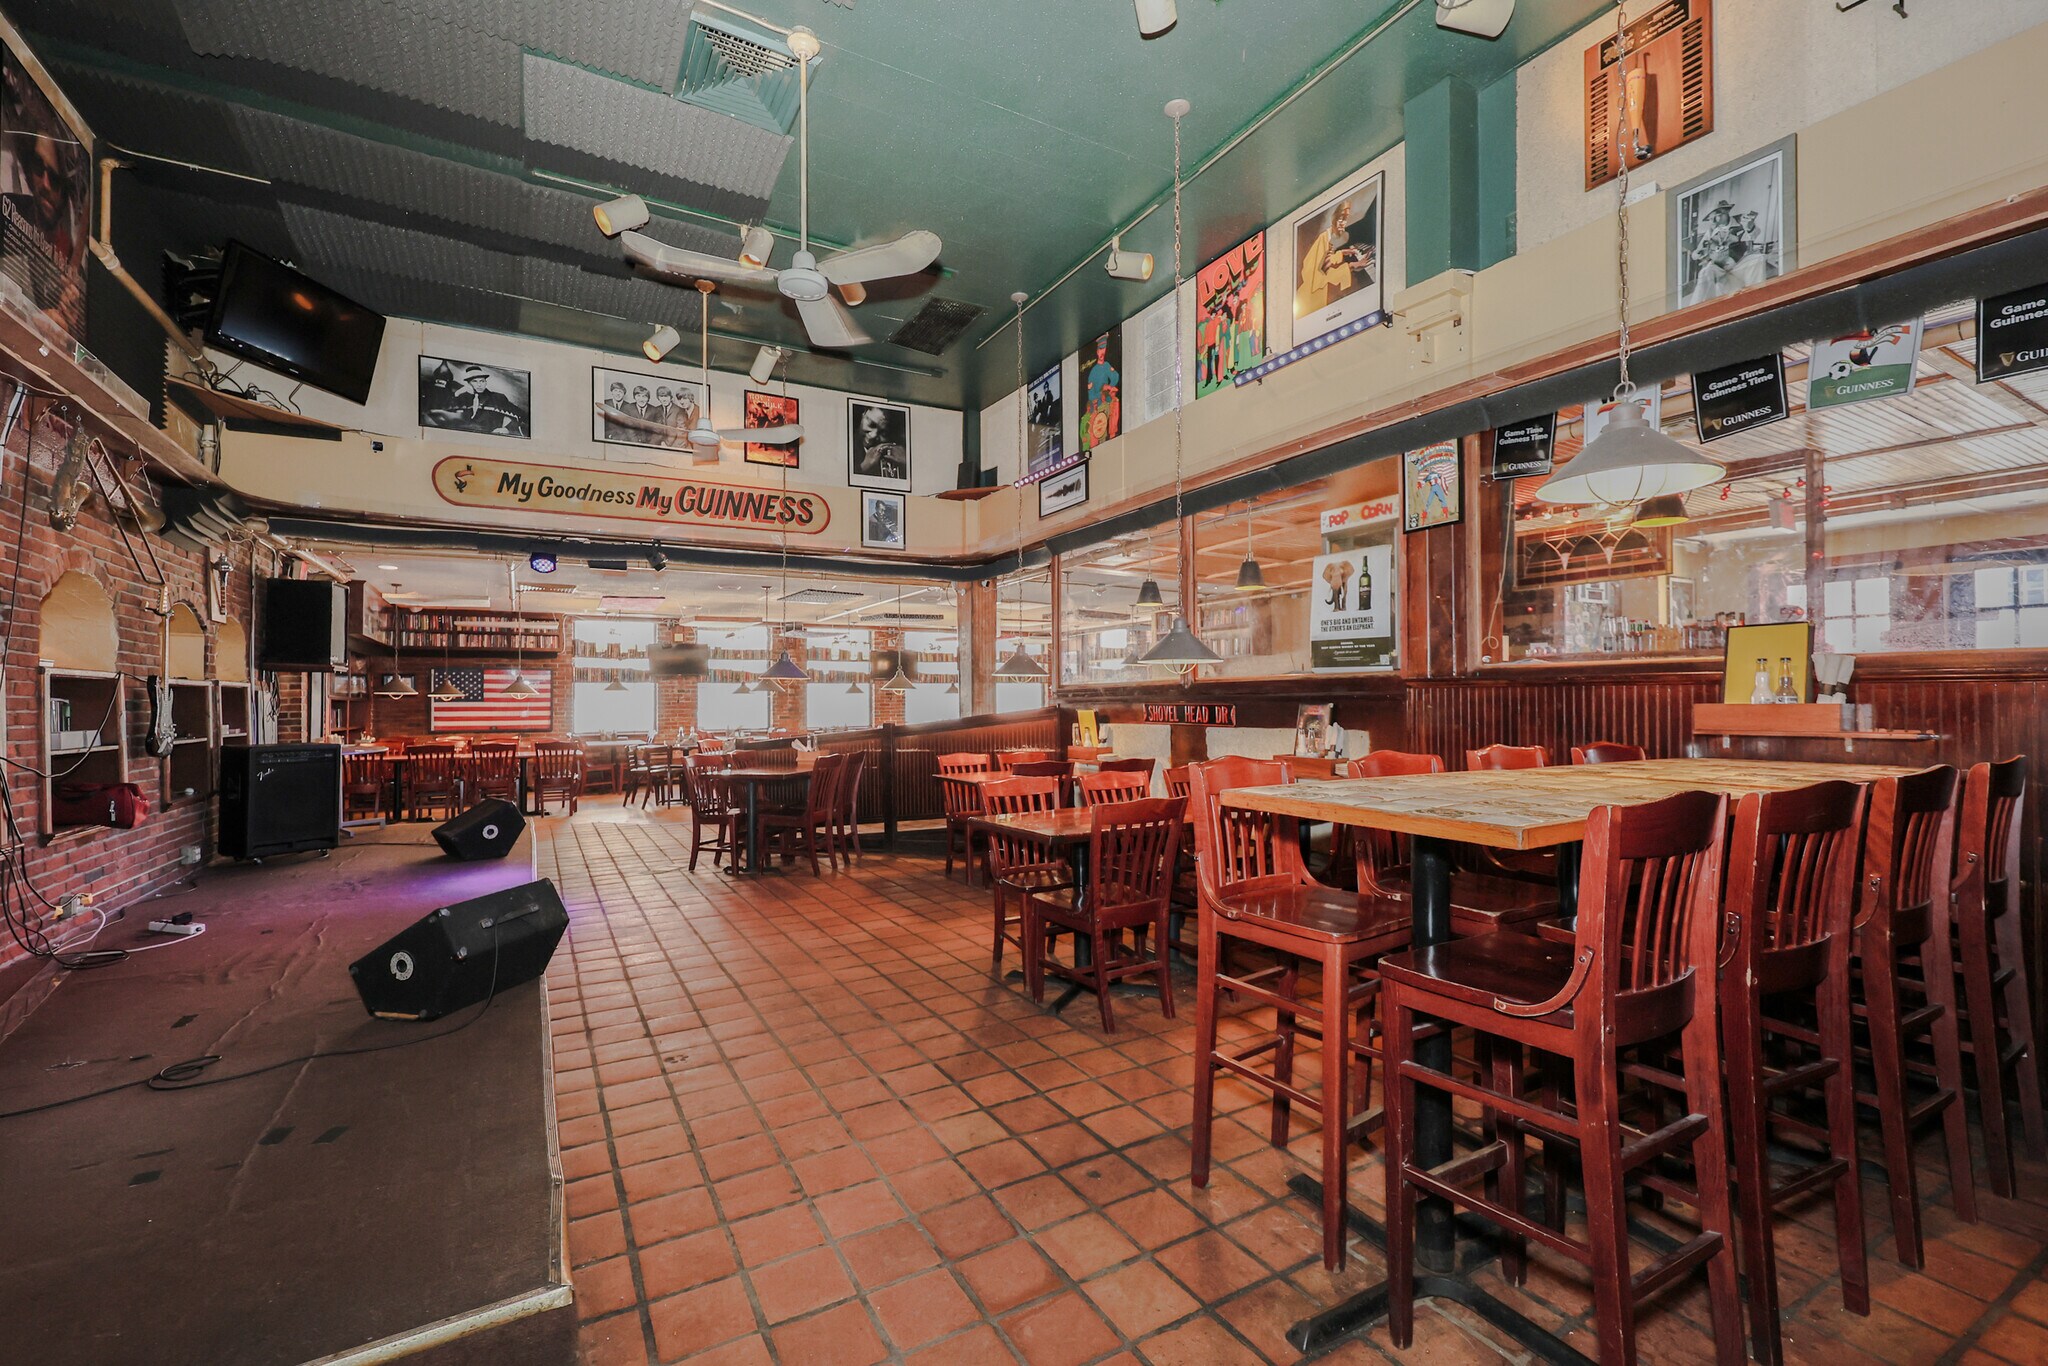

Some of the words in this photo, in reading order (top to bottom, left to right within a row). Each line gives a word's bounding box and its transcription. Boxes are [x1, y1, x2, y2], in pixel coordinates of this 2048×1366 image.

[2, 194, 11, 220] 62
[1200, 233, 1264, 306] LOVE
[2001, 299, 2046, 315] Game
[1702, 382, 1747, 401] Guinness
[1747, 373, 1774, 386] Time
[1708, 377, 1738, 390] Game
[1739, 368, 1765, 380] Time
[1836, 378, 1894, 395] GUINNESS
[1722, 405, 1772, 426] GUINNESS
[1499, 437, 1530, 446] Guinness
[1530, 433, 1549, 441] Time
[1504, 430, 1525, 438] Game
[1525, 427, 1544, 435] Time
[1508, 461, 1541, 471] GUINNESS
[497, 472, 534, 502] My
[537, 476, 636, 505] Goodness
[635, 486, 672, 516] My
[675, 485, 813, 526] GUINNESS
[1328, 510, 1349, 527] POP
[1361, 503, 1393, 520] CORN
[1148, 705, 1179, 722] SHOVEL
[1184, 705, 1209, 723] HEAD
[1215, 706, 1228, 723] DR
